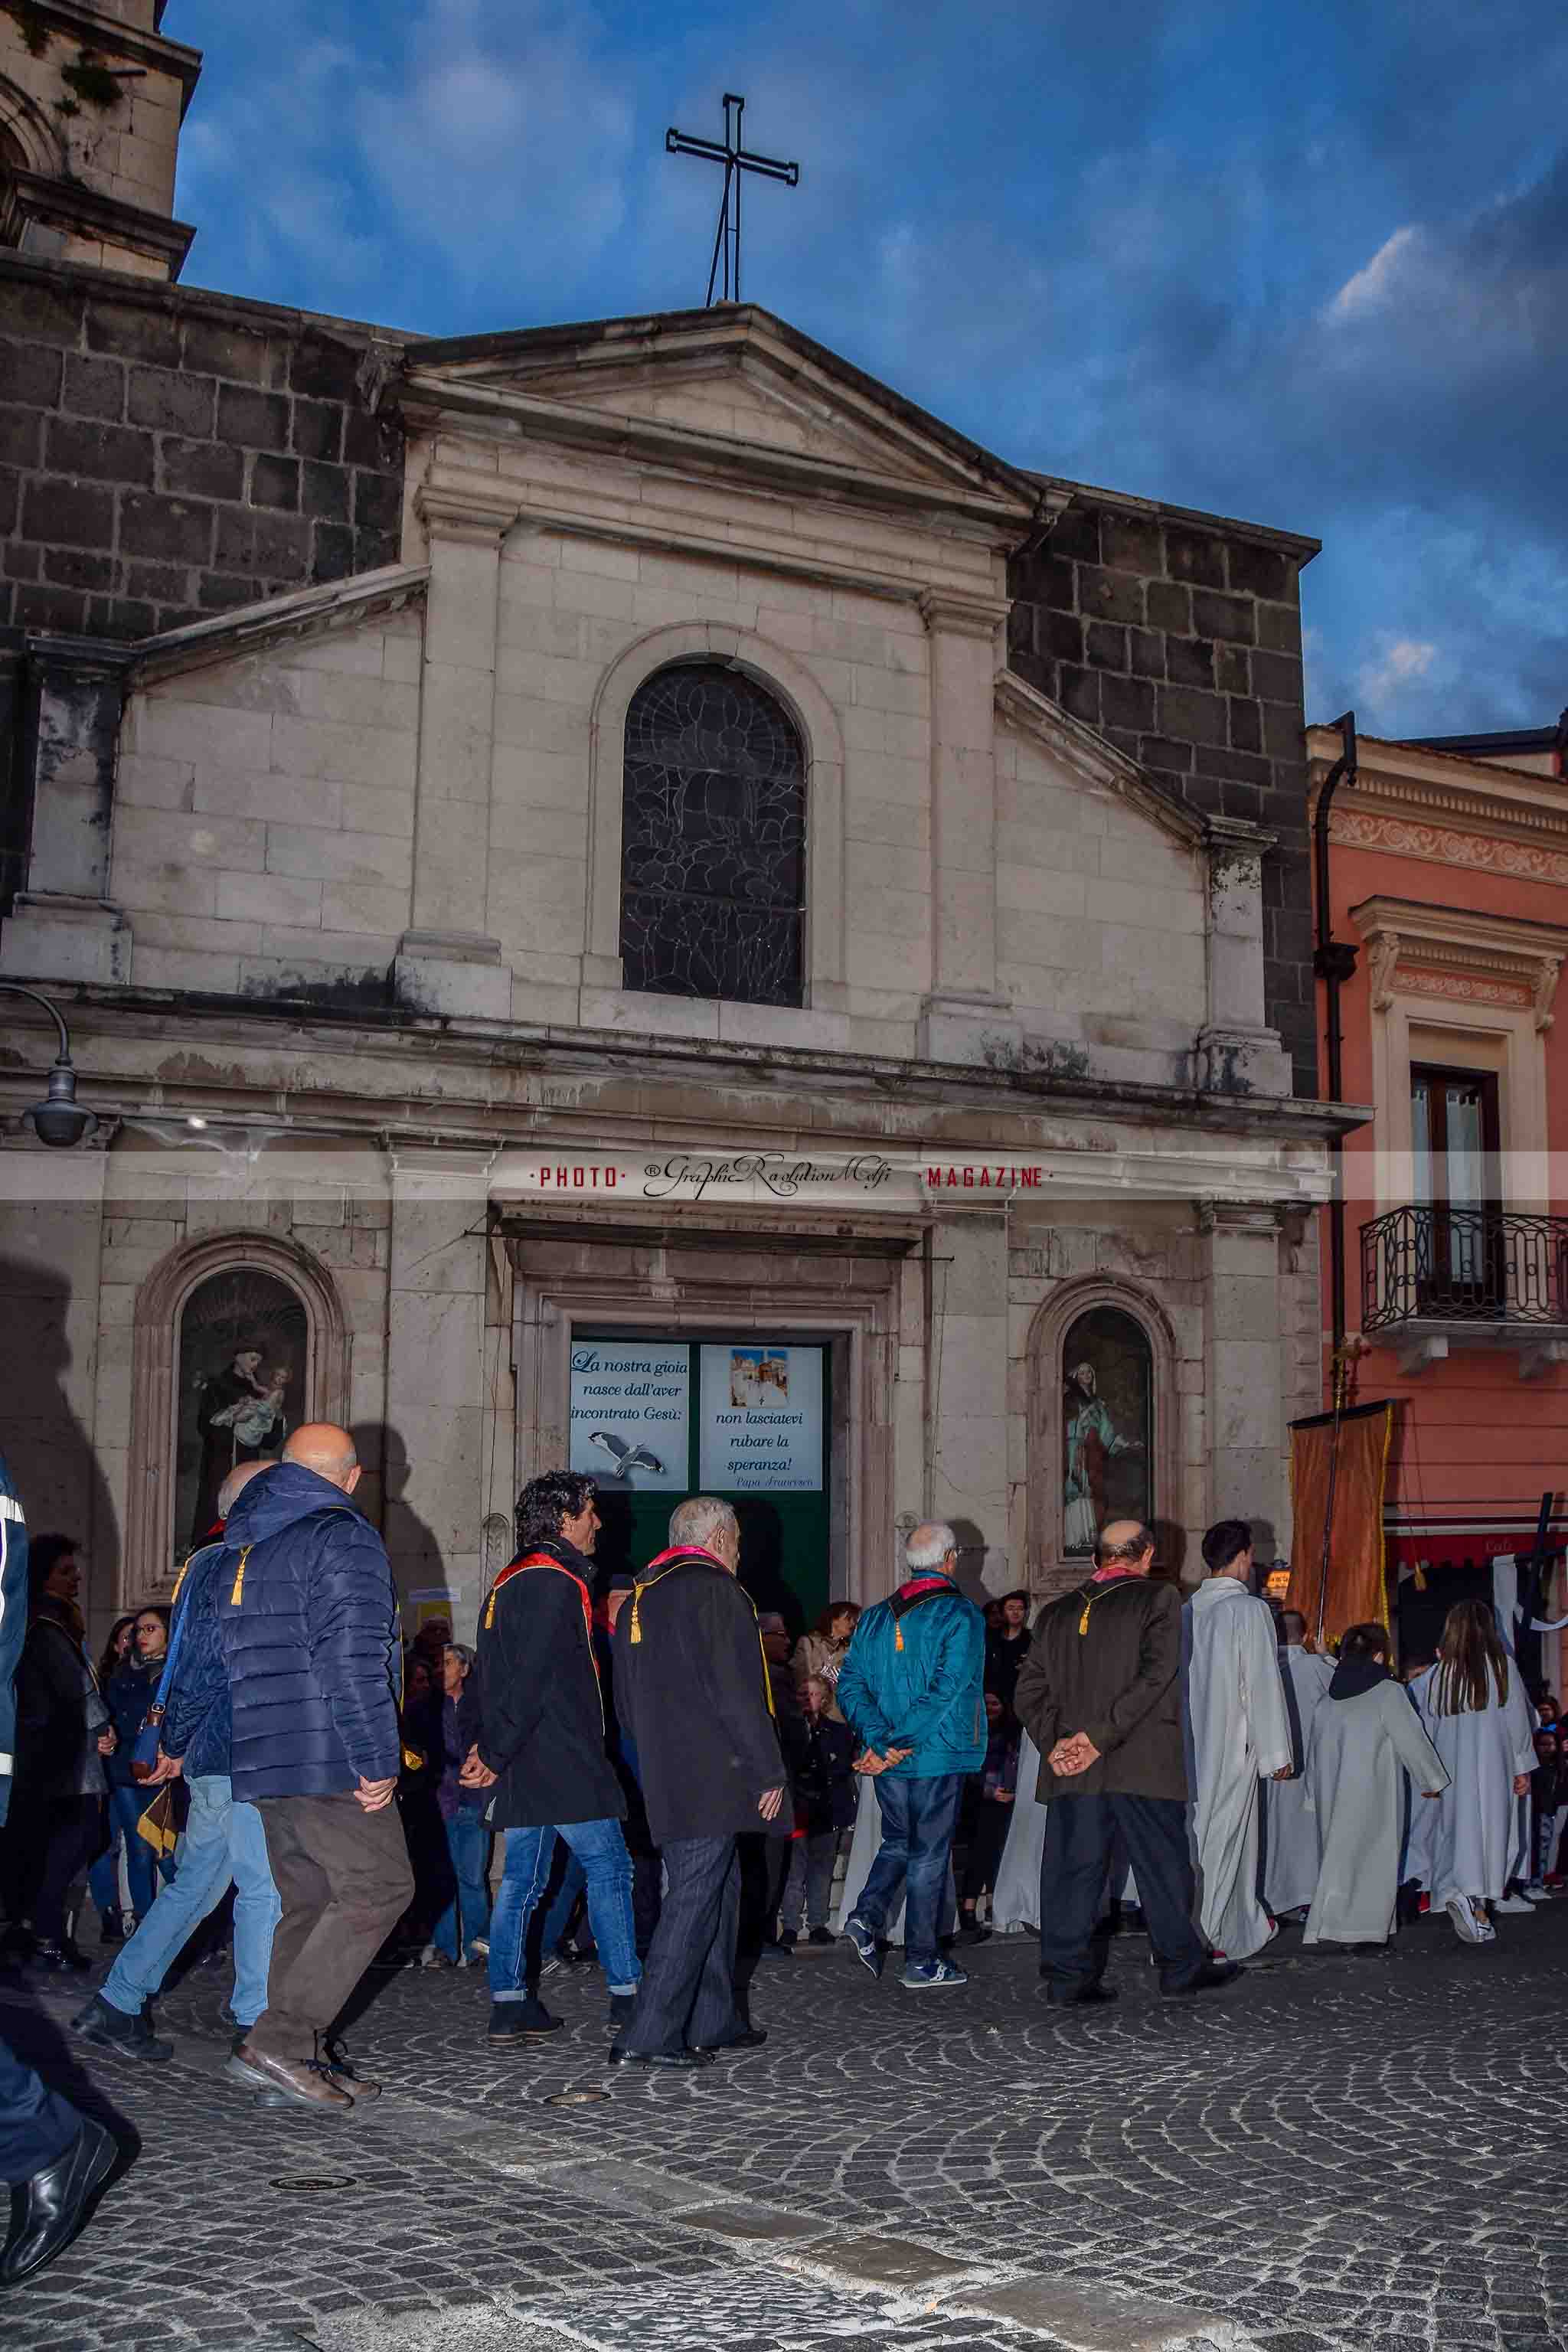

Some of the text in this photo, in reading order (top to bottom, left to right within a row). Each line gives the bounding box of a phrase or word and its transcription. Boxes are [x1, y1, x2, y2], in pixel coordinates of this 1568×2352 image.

[570, 1351, 688, 1377] La nostra gioia
[583, 1383, 682, 1396] nasce dall'aver
[570, 1406, 681, 1420] incontrato Gesù:
[716, 1411, 803, 1425] non lasciatevi
[730, 1434, 790, 1447] rubare la
[727, 1458, 792, 1474] speranza!
[736, 1476, 761, 1489] Papa
